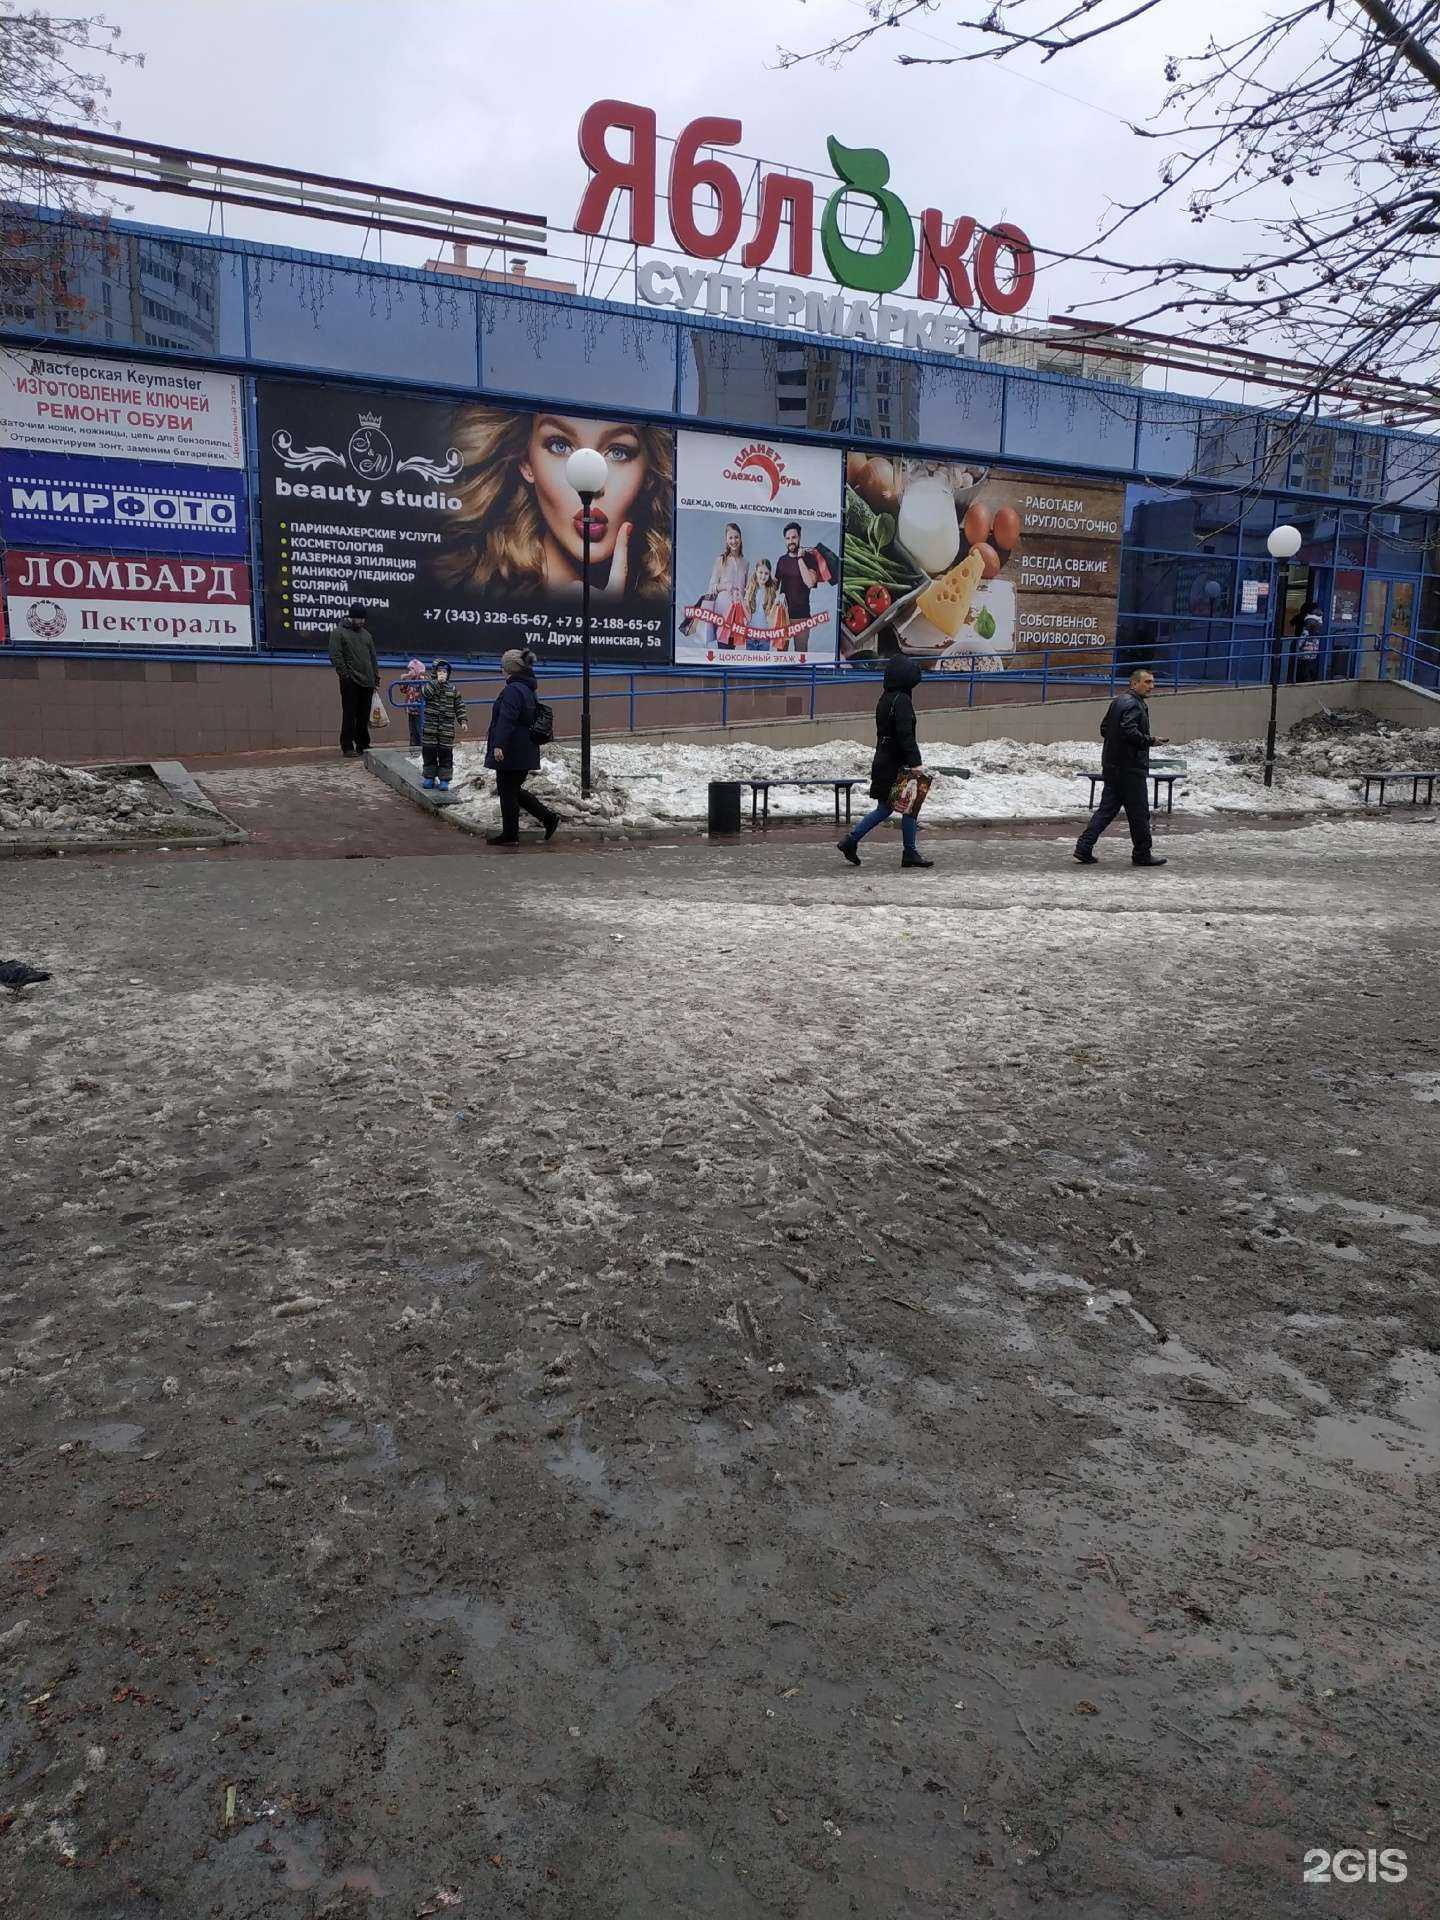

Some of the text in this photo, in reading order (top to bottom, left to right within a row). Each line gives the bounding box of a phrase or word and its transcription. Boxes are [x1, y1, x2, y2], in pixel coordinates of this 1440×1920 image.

[637, 260, 985, 358] СУПЕРМАРКЕТ
[32, 359, 202, 391] Мастерская Keymaster
[16, 377, 209, 412] ИЗГОТОВЛЕНИЕ КЛЮЧЕЙ
[37, 401, 193, 431] РЕМОНТ ОБУВИ
[48, 423, 77, 434] ножи,
[80, 427, 128, 439] ножницы,
[131, 431, 155, 442] цепь
[157, 434, 175, 443] для
[10, 432, 96, 449] Отремонтируем
[98, 442, 124, 452] зонт,
[127, 445, 171, 456] заменим
[733, 443, 787, 473] ПЛАНЕТА
[275, 477, 463, 511] beauty studio
[1026, 496, 1083, 512] РАБОТАЕМ
[680, 498, 714, 509] ОДЕЖДА,
[714, 501, 739, 511] ОБУВЬ,
[740, 504, 783, 514] АКСЕССУАРЫ
[784, 507, 798, 516] ДЛЯ
[798, 508, 815, 517] ВСЕЙ
[290, 522, 442, 544] ПАРИКМАХЕРСКИЕ УСЛУГИ
[1024, 514, 1118, 534] КРУГЛОСУТОЧНО
[290, 537, 384, 553] КОСМЕТОЛОГИЯ
[291, 551, 417, 570] ЛАЗЕРНАЯ ЭПИЛЯЦИЯ
[1022, 556, 1062, 571] ВСЕГДА
[1065, 559, 1108, 573] СВЕЖИЕ
[19, 557, 237, 600] ЛОМБАРД
[291, 565, 415, 582] МАНИКЮР/ПЕДИКЮР
[1021, 574, 1081, 590] ПРОДУКТЫ
[292, 579, 348, 592] СОЛЯРИЙ
[293, 607, 350, 619] ШУГАРИН
[423, 609, 662, 631] +7 (343) 328-65-67, +7 92-188-65-67
[685, 607, 724, 626] МОДНО
[732, 624, 745, 636] НЕ
[747, 628, 785, 639] ЗНАЧИТ
[787, 611, 830, 637] ДОРОГО!
[1018, 614, 1098, 630] СОБСТВЕННОЕ
[81, 610, 237, 637] Пектораль
[525, 632, 662, 648] ул. Дружнинская, 5а
[1018, 631, 1106, 648] ПРОИЗВОДСТВО
[718, 653, 796, 664] ЦОКОЛЬНЫЙ ЭТАЖ
